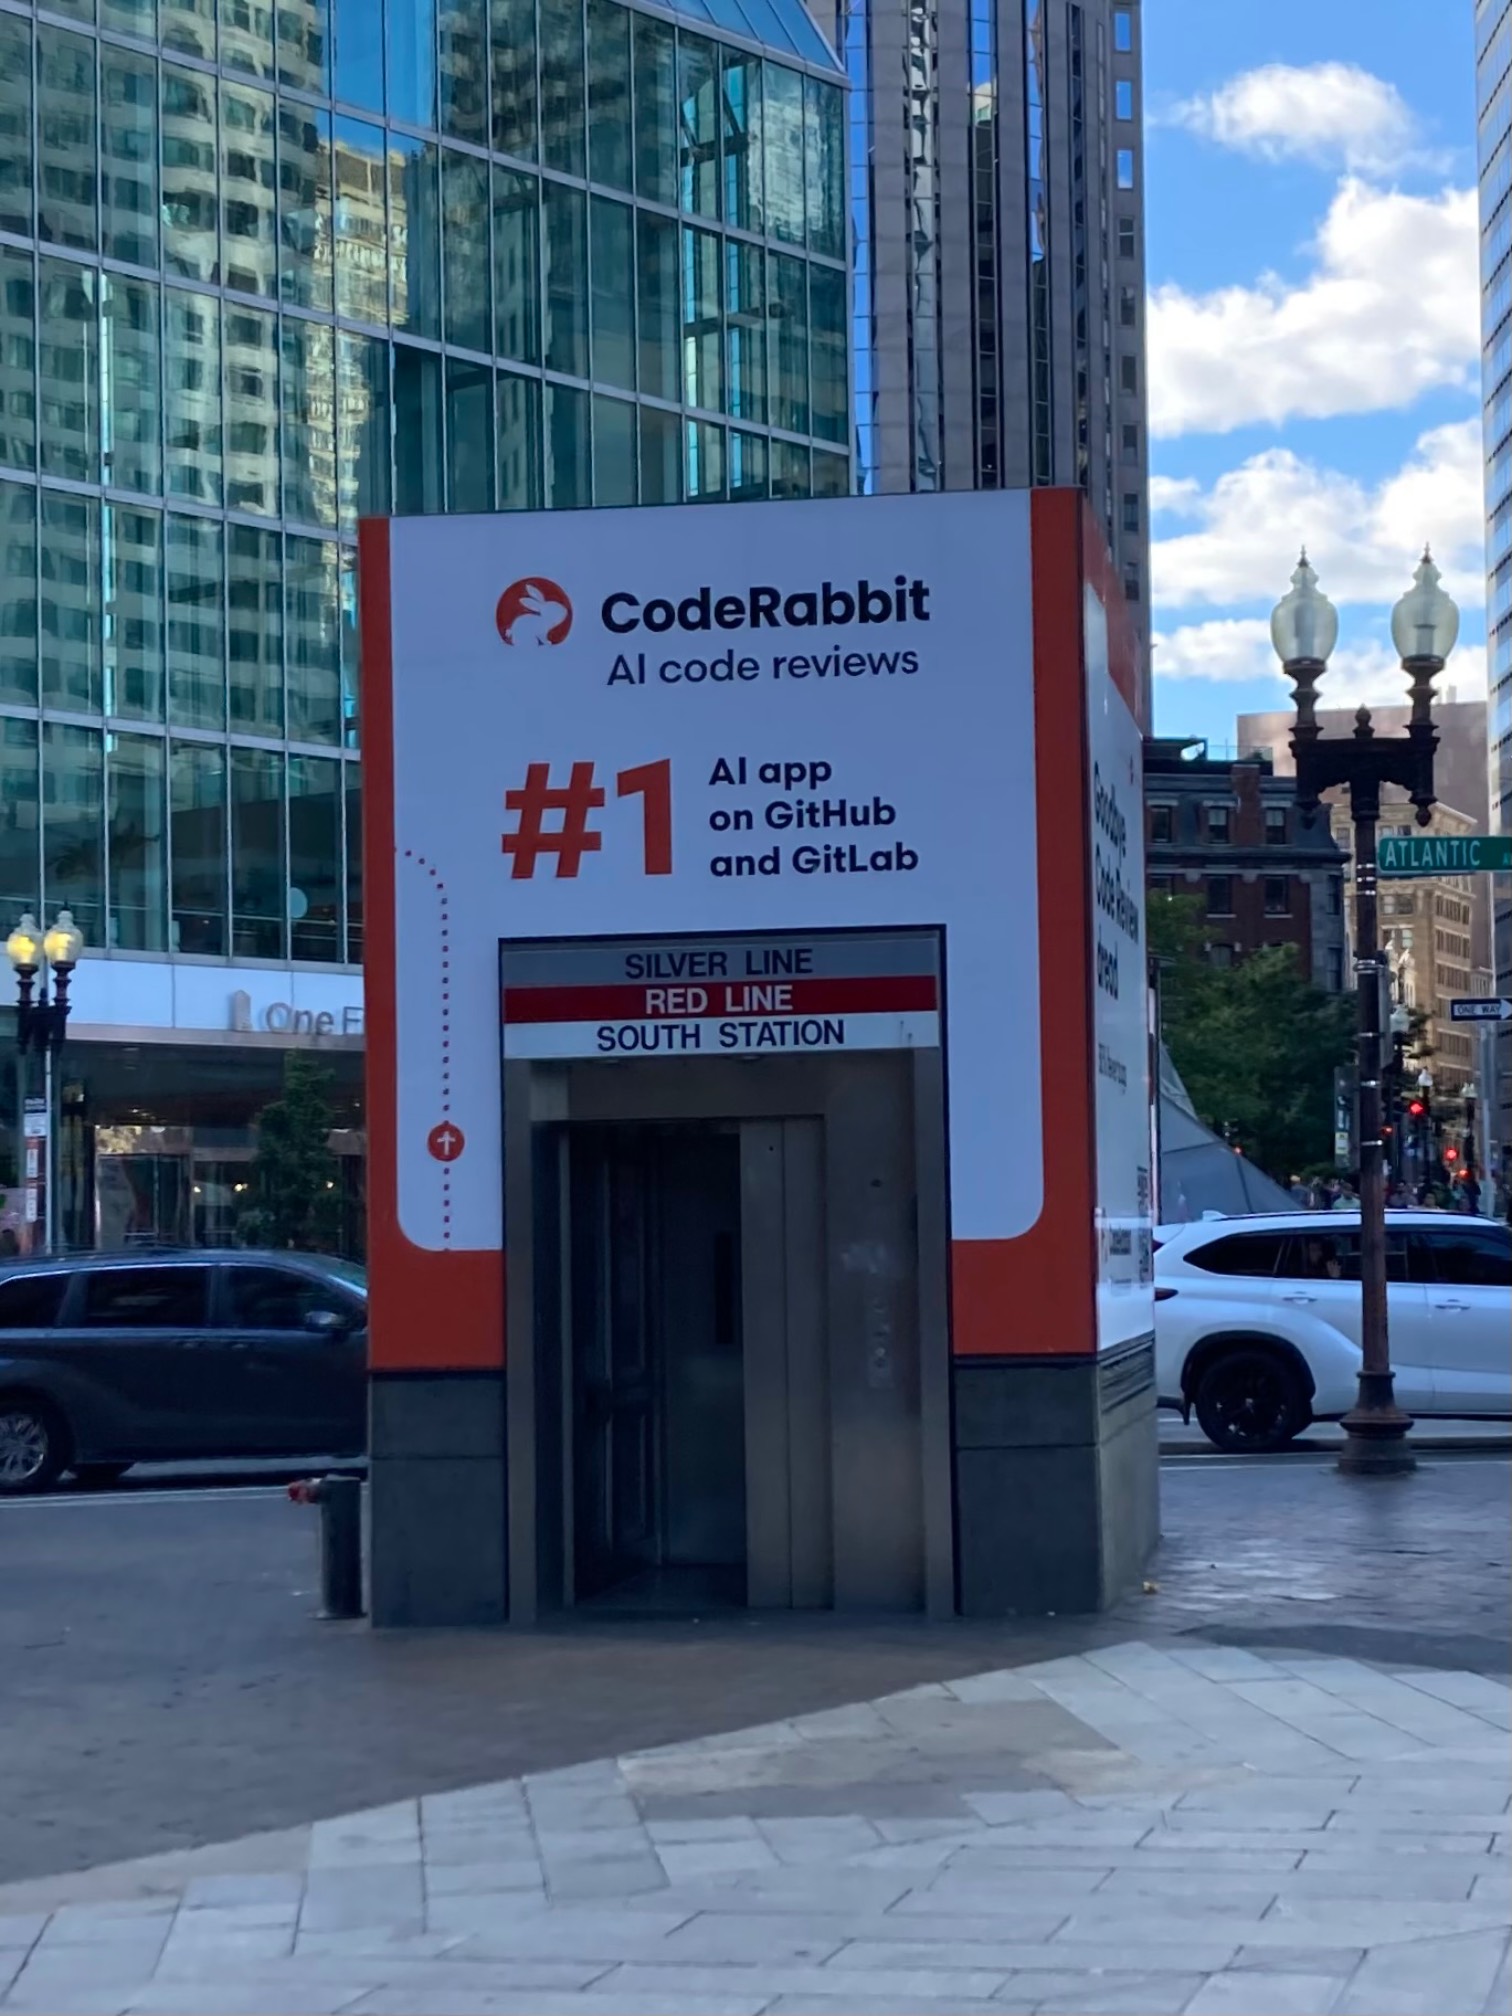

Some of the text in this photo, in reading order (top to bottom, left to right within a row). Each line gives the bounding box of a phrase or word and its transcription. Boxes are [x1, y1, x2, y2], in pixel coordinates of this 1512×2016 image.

[602, 576, 930, 634] CodeRabbit
[606, 645, 919, 686] AI code reviews
[708, 757, 832, 791] AI app
[501, 757, 672, 880] #1
[709, 797, 896, 831] on GitHub
[1094, 760, 1126, 868] Goodbye
[710, 842, 918, 877] and GitLab
[1384, 840, 1481, 867] ATLANTIC
[1096, 842, 1139, 946] Code Review
[625, 948, 813, 979] SILVER LINE
[1097, 923, 1119, 1000] dread
[646, 984, 793, 1014] RED LINE
[1457, 1003, 1501, 1015] ONE WAY
[265, 1002, 334, 1036] One
[597, 1019, 844, 1051] SOUTH STATION
